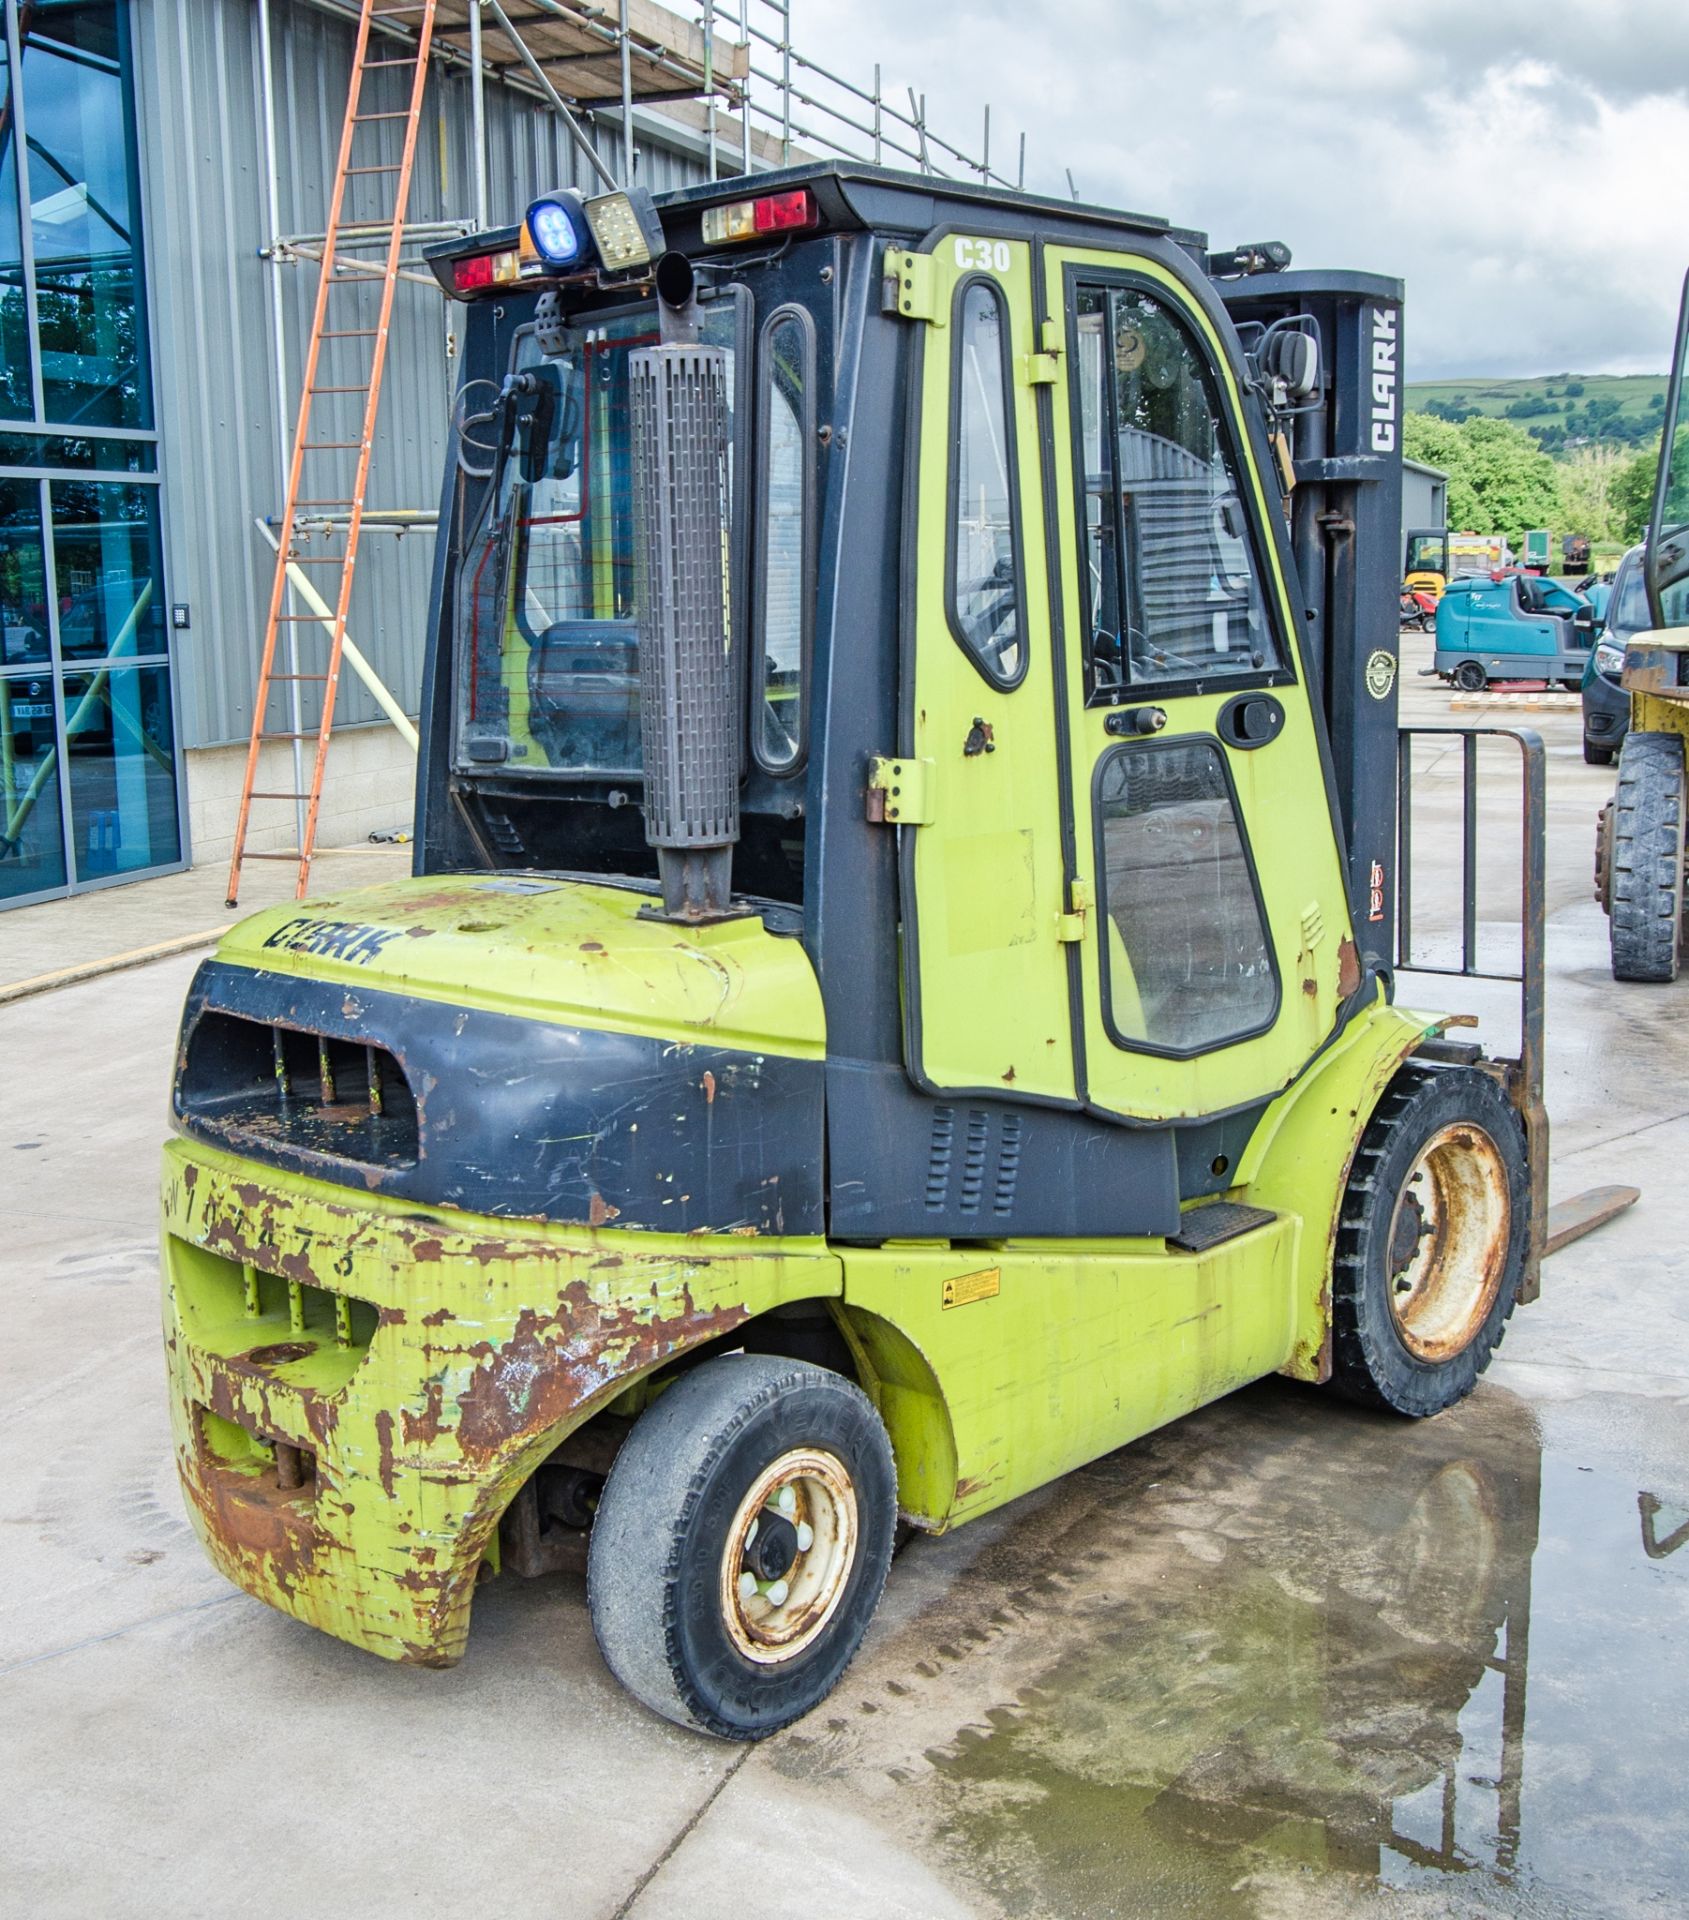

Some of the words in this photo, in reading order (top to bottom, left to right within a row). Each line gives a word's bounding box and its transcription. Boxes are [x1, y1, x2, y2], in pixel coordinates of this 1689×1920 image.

[955, 238, 1010, 272] C30
[1372, 308, 1396, 452] CLARK
[262, 918, 402, 965] CLARK
